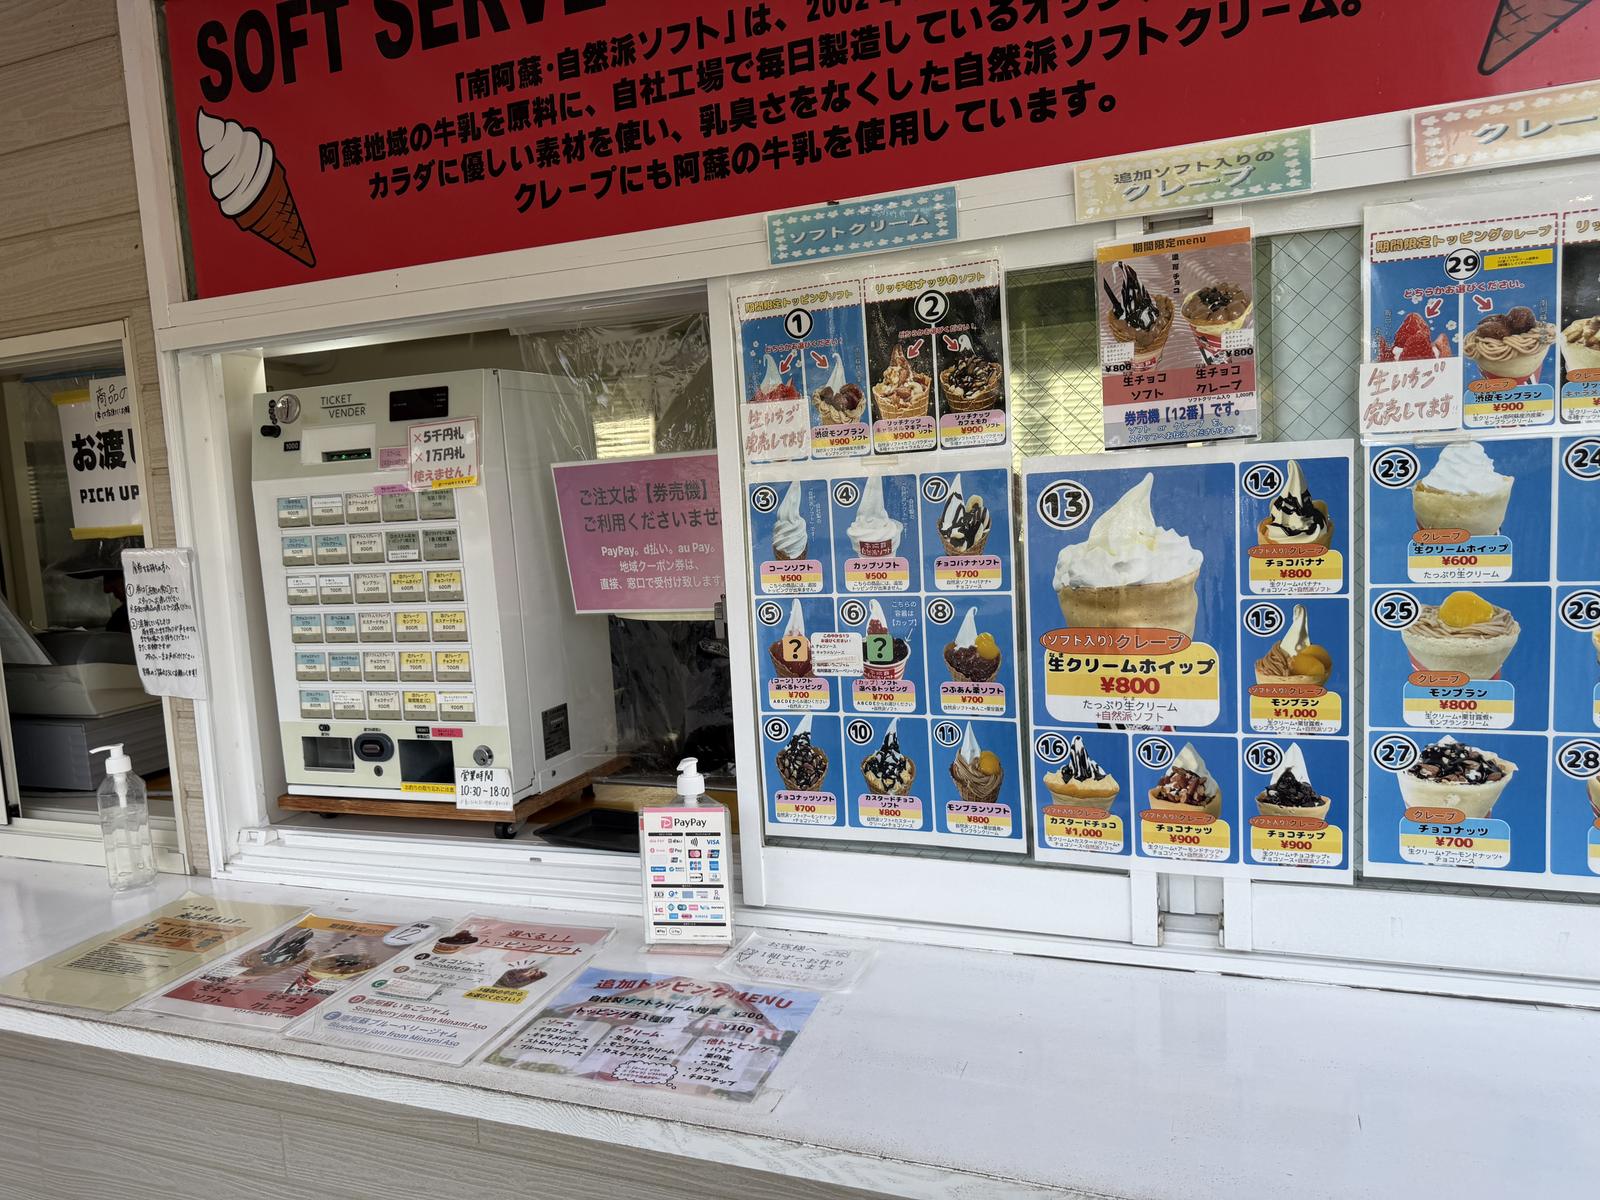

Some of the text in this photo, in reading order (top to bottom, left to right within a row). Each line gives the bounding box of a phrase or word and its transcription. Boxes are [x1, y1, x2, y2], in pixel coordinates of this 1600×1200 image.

[196, 0, 607, 102] SOFT SER
[515, 80, 1117, 214] クレープにも阿蘇の牛乳を使用しています。
[1112, 148, 1276, 186] 追加ソフト入りの
[1122, 165, 1257, 202] クレープ
[789, 211, 930, 244] ソフトクリーム
[1133, 235, 1206, 254] 期間限定menu
[1376, 225, 1551, 253] 期間限定トッピングクレープ
[875, 271, 986, 295] リッチなナッツのソフト
[1404, 280, 1524, 298] どちらかお選びください。
[1225, 348, 1254, 359] ¥800
[1104, 363, 1132, 372] ¥800
[1196, 366, 1241, 381] 生チョコ
[1368, 361, 1446, 396] 生いちご
[1123, 373, 1167, 388] 生チョコ
[1196, 379, 1242, 394] クレープ
[320, 393, 353, 406] TICKET
[1131, 388, 1164, 401] ソフト
[1493, 401, 1524, 411] ¥900
[328, 406, 366, 419] VENDER
[1124, 401, 1240, 426] 券売機【12番】です。
[957, 417, 987, 426] カフェモカ
[960, 426, 984, 434] ¥900
[893, 432, 915, 440] ¥900
[829, 438, 850, 447] ¥900
[80, 485, 140, 504] PICK UP
[583, 508, 720, 534] ご利用くださいませ
[1414, 544, 1509, 554] 生クリームホイップ
[619, 559, 700, 574] 地域クーポン券は、
[853, 560, 900, 570] カップソフト
[935, 557, 1000, 568] チョコバナナソフト
[1264, 558, 1325, 568] チョコバナナ
[1442, 556, 1478, 566] ¥600
[768, 563, 814, 572] コーンソフト
[1279, 568, 1312, 578] ¥800
[780, 573, 802, 582] ¥500
[865, 571, 888, 580] ¥500
[955, 569, 979, 578] ¥700
[1424, 570, 1499, 579] たっぷり生クリーム
[599, 575, 722, 591] 直接、窓口で受付け致します
[1048, 657, 1216, 676] 生クリームホイップ
[1418, 674, 1460, 683] クレープ
[775, 683, 823, 691] 選べるトッピング
[859, 685, 908, 693] 選べるトッピング
[1099, 676, 1160, 695] ¥800
[788, 691, 810, 699] ¥700
[872, 693, 895, 701] ¥700
[1429, 688, 1488, 698] モンブラン
[961, 695, 984, 704] ¥700
[1270, 698, 1319, 707] モンブラン
[1439, 700, 1477, 710] ¥800
[1082, 700, 1178, 713] たっぷり生クリーム
[1273, 708, 1317, 718] ¥1,000
[460, 769, 494, 782] 営業時間
[776, 793, 835, 803] チョコナッツソフト
[865, 795, 915, 804] カスタードチョコ
[794, 804, 816, 813] ¥700
[878, 808, 901, 818] ¥800
[947, 803, 1010, 815] モンブランソフト
[966, 815, 990, 825] ¥800
[1414, 811, 1456, 820] クレープ
[674, 817, 708, 829] PayPay
[1050, 816, 1117, 829] カスタードチョコ
[1064, 827, 1103, 837] ¥1,000
[1155, 823, 1213, 835] チョコナッツ
[1418, 825, 1489, 836] チョコナッツ
[1169, 833, 1201, 845] ¥900
[1267, 829, 1325, 841] チョコチップ
[1280, 839, 1312, 850] ¥900
[1435, 837, 1474, 848] ¥700
[1435, 856, 1475, 865] チョコソース
[478, 938, 583, 956] トッピングソフト
[421, 960, 459, 972] Chocolate
[593, 978, 794, 1010] 追加トッピングMENU
[352, 1005, 399, 1019] Strawberry
[437, 1017, 471, 1029] Minami
[470, 1023, 488, 1031] Aso
[733, 1011, 764, 1021] ¥200
[722, 1023, 754, 1034] ¥100
[442, 1040, 461, 1048] Aso
